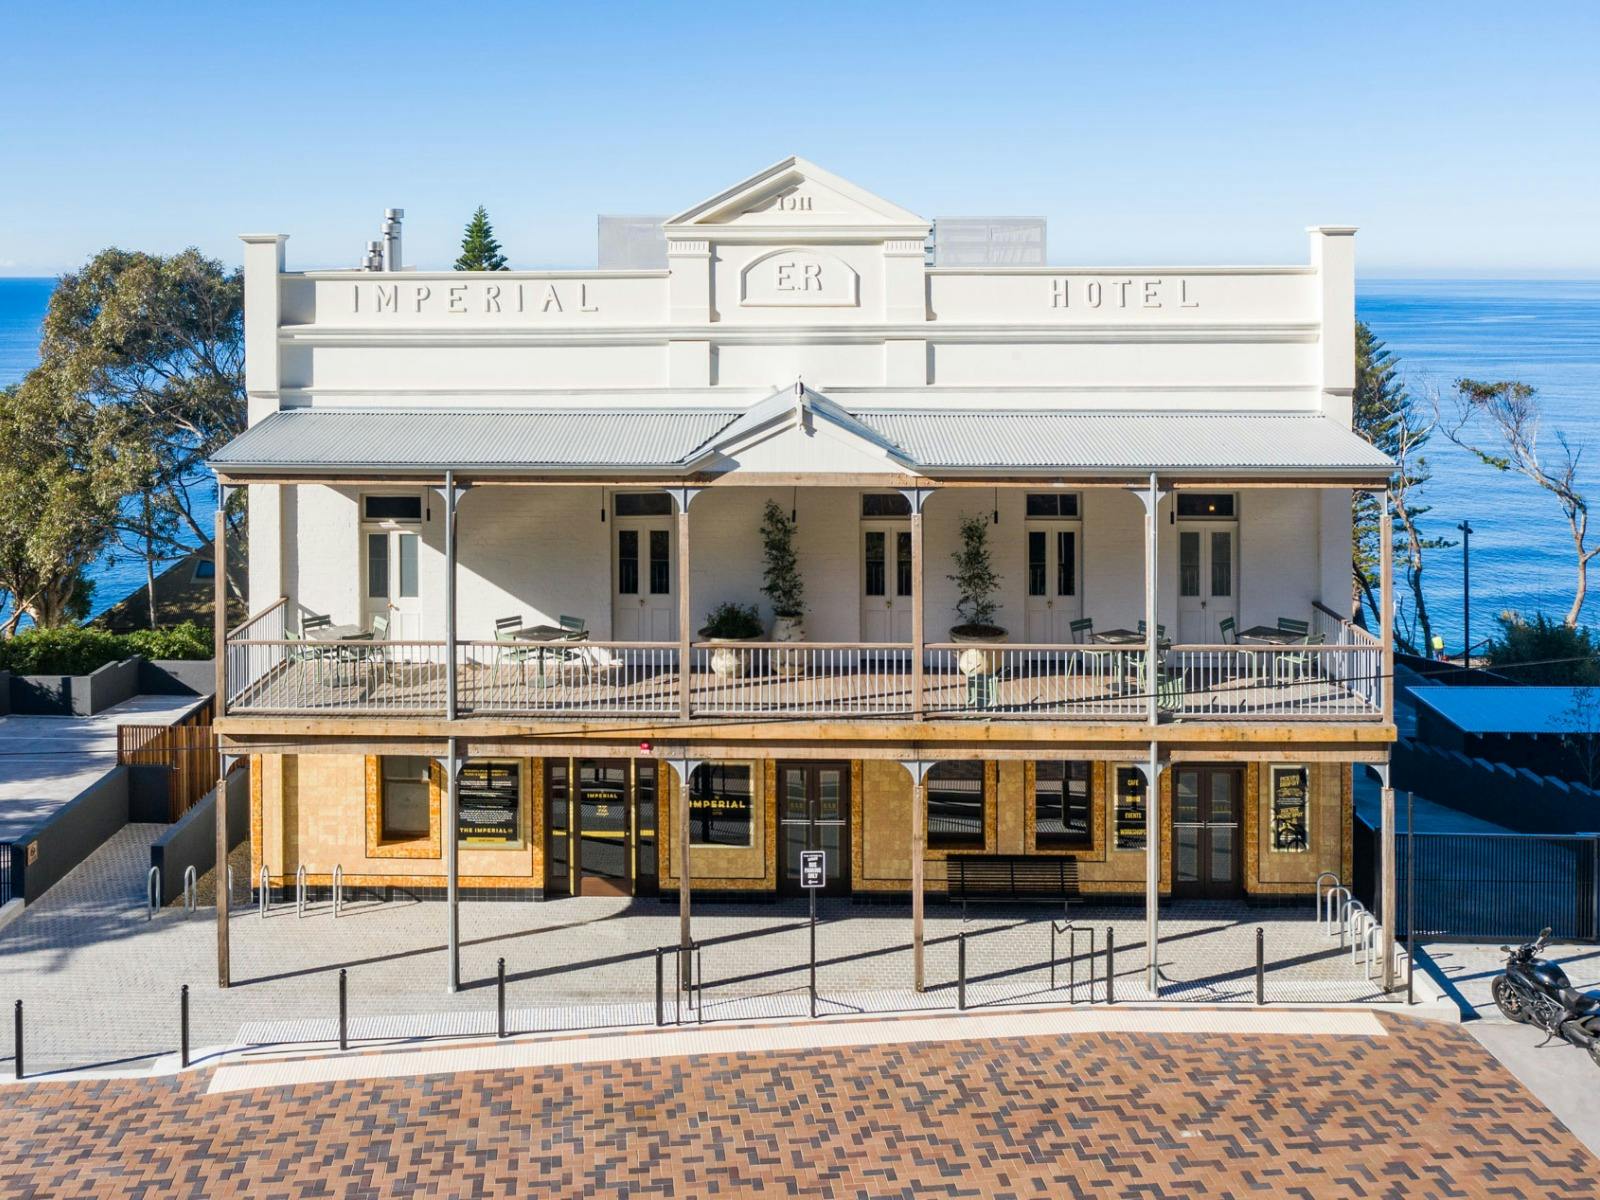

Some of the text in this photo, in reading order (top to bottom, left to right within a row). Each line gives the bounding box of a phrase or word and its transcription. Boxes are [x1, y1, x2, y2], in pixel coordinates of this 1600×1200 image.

[353, 282, 600, 314] IMPERIAL
[1050, 278, 1200, 308] HOTEL
[688, 800, 747, 809] IMPERIAL
